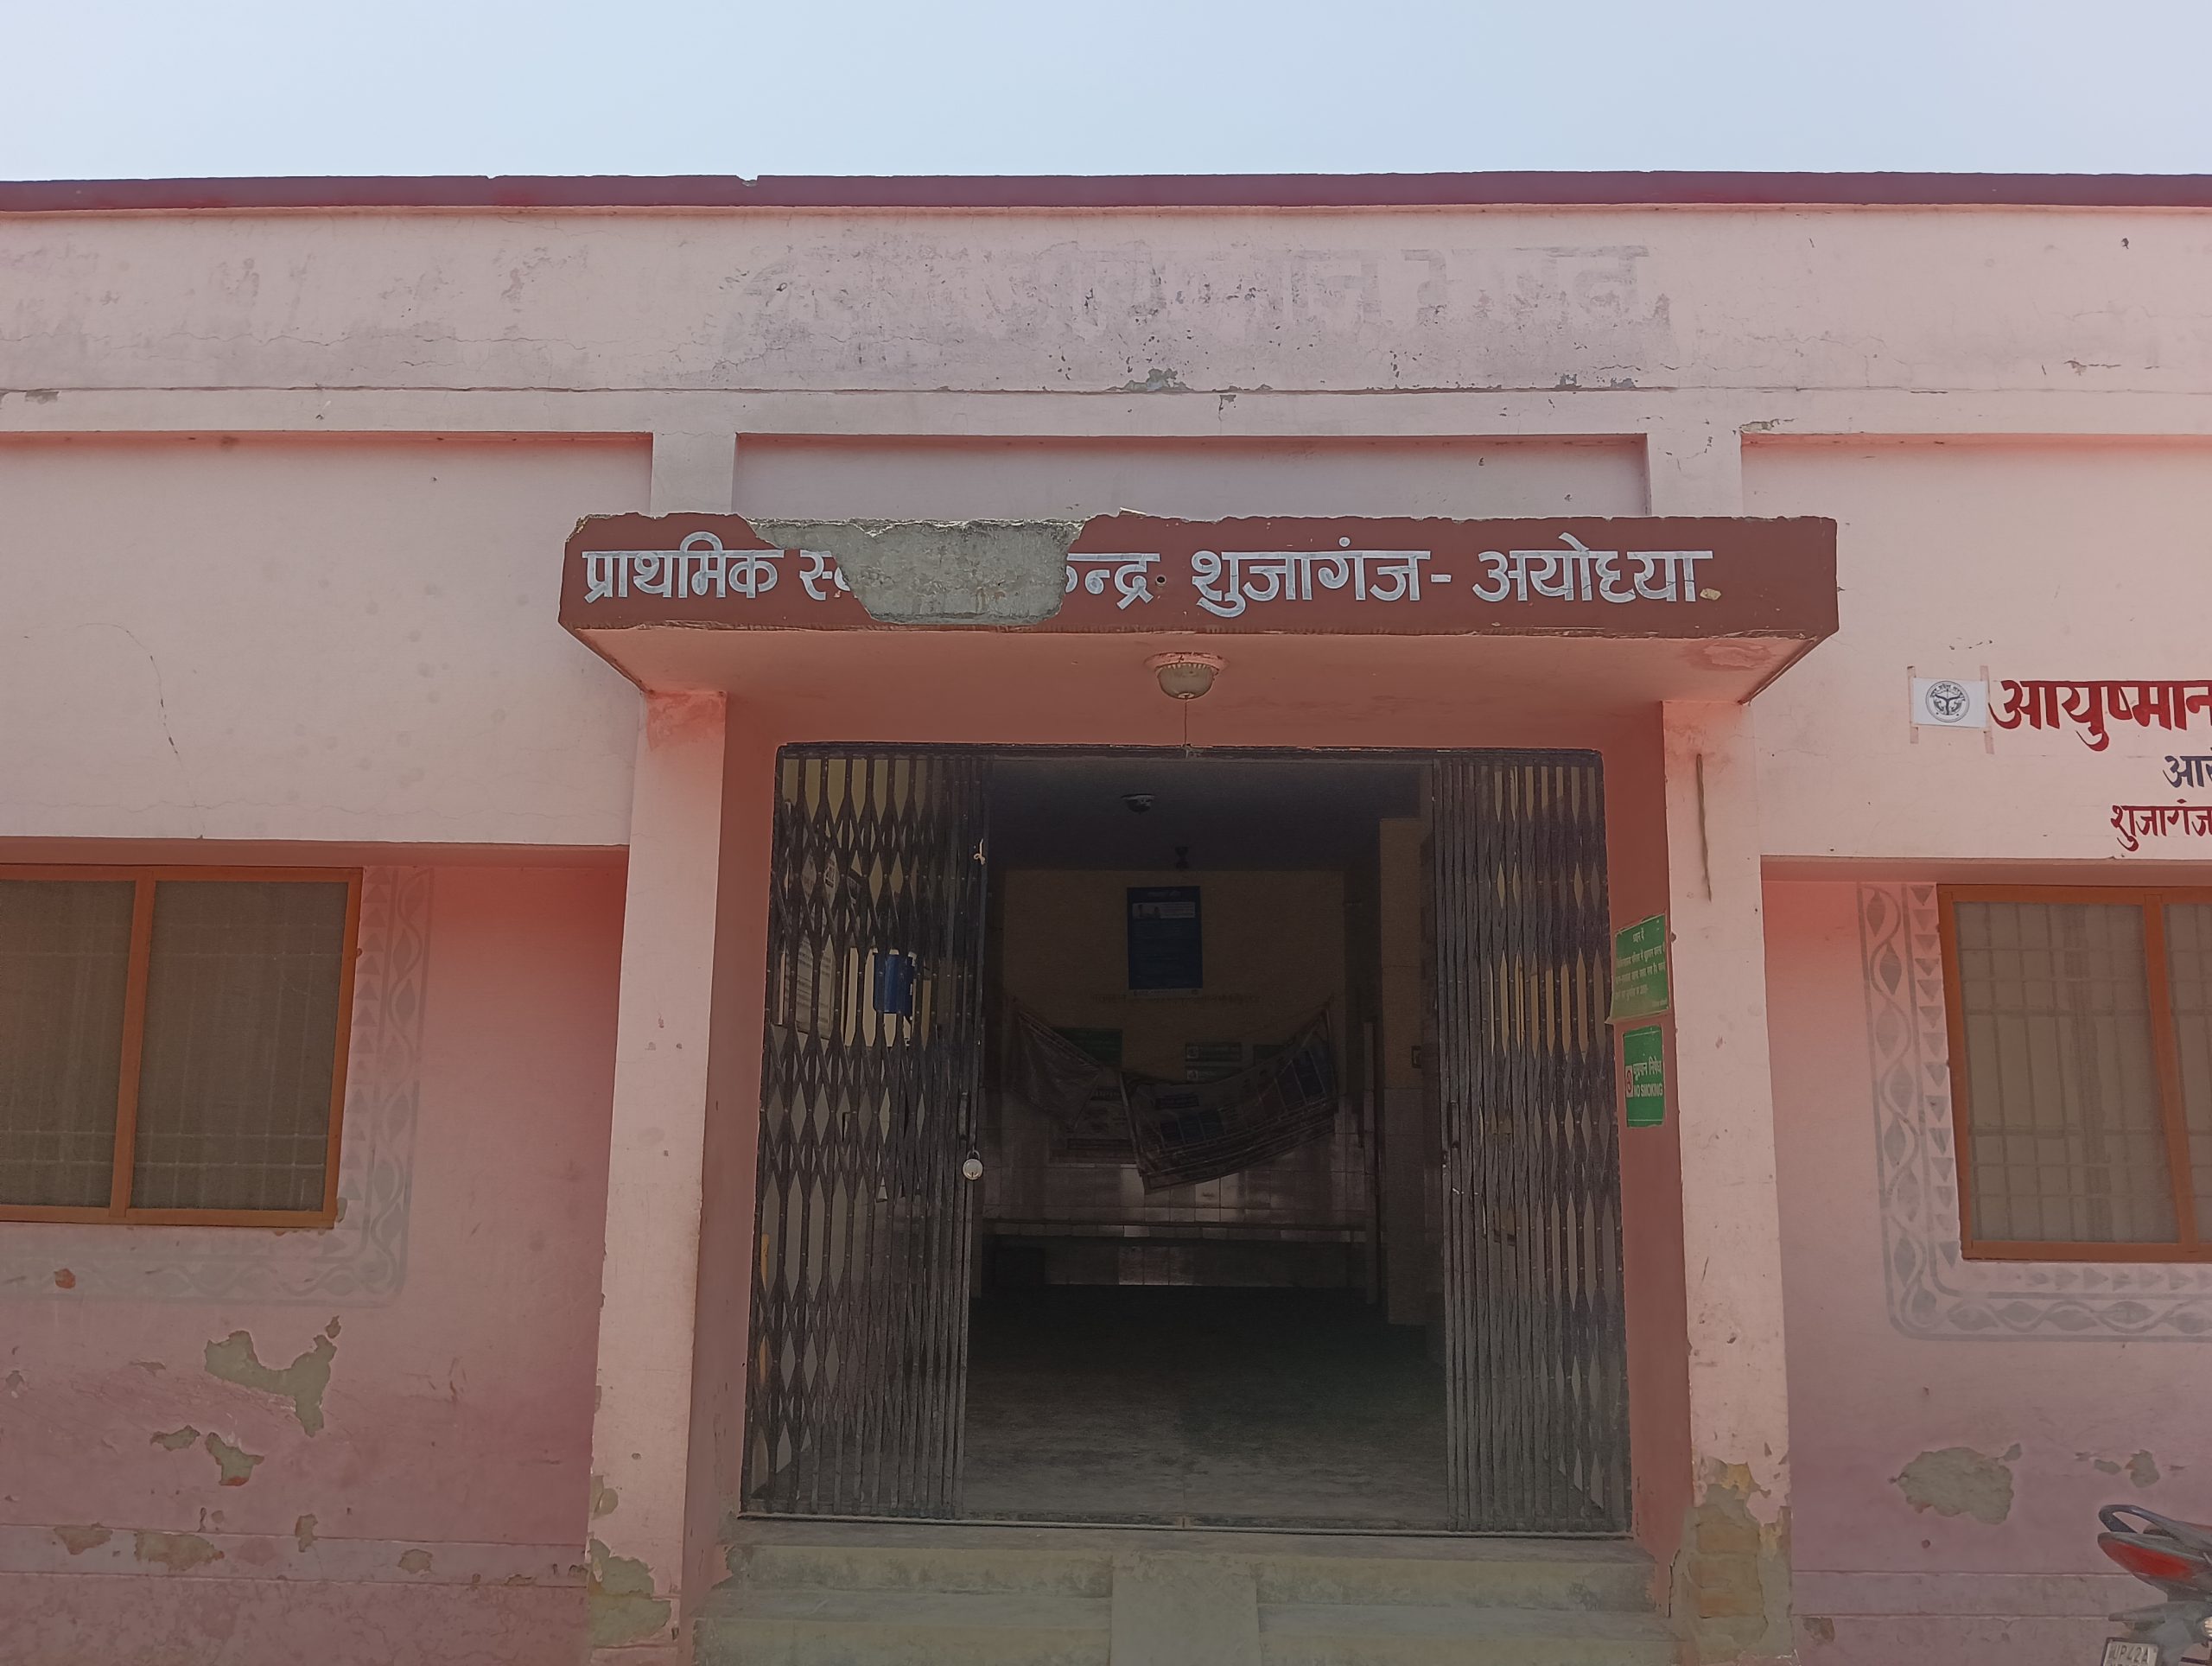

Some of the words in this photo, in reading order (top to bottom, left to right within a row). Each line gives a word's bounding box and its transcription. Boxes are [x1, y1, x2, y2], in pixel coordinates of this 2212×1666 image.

[582, 531, 784, 603] प्राथमिक
[1471, 532, 1713, 603] अयोध्या
[1633, 1084, 1641, 1097] NO
[1641, 1083, 1663, 1097] SMOKING
